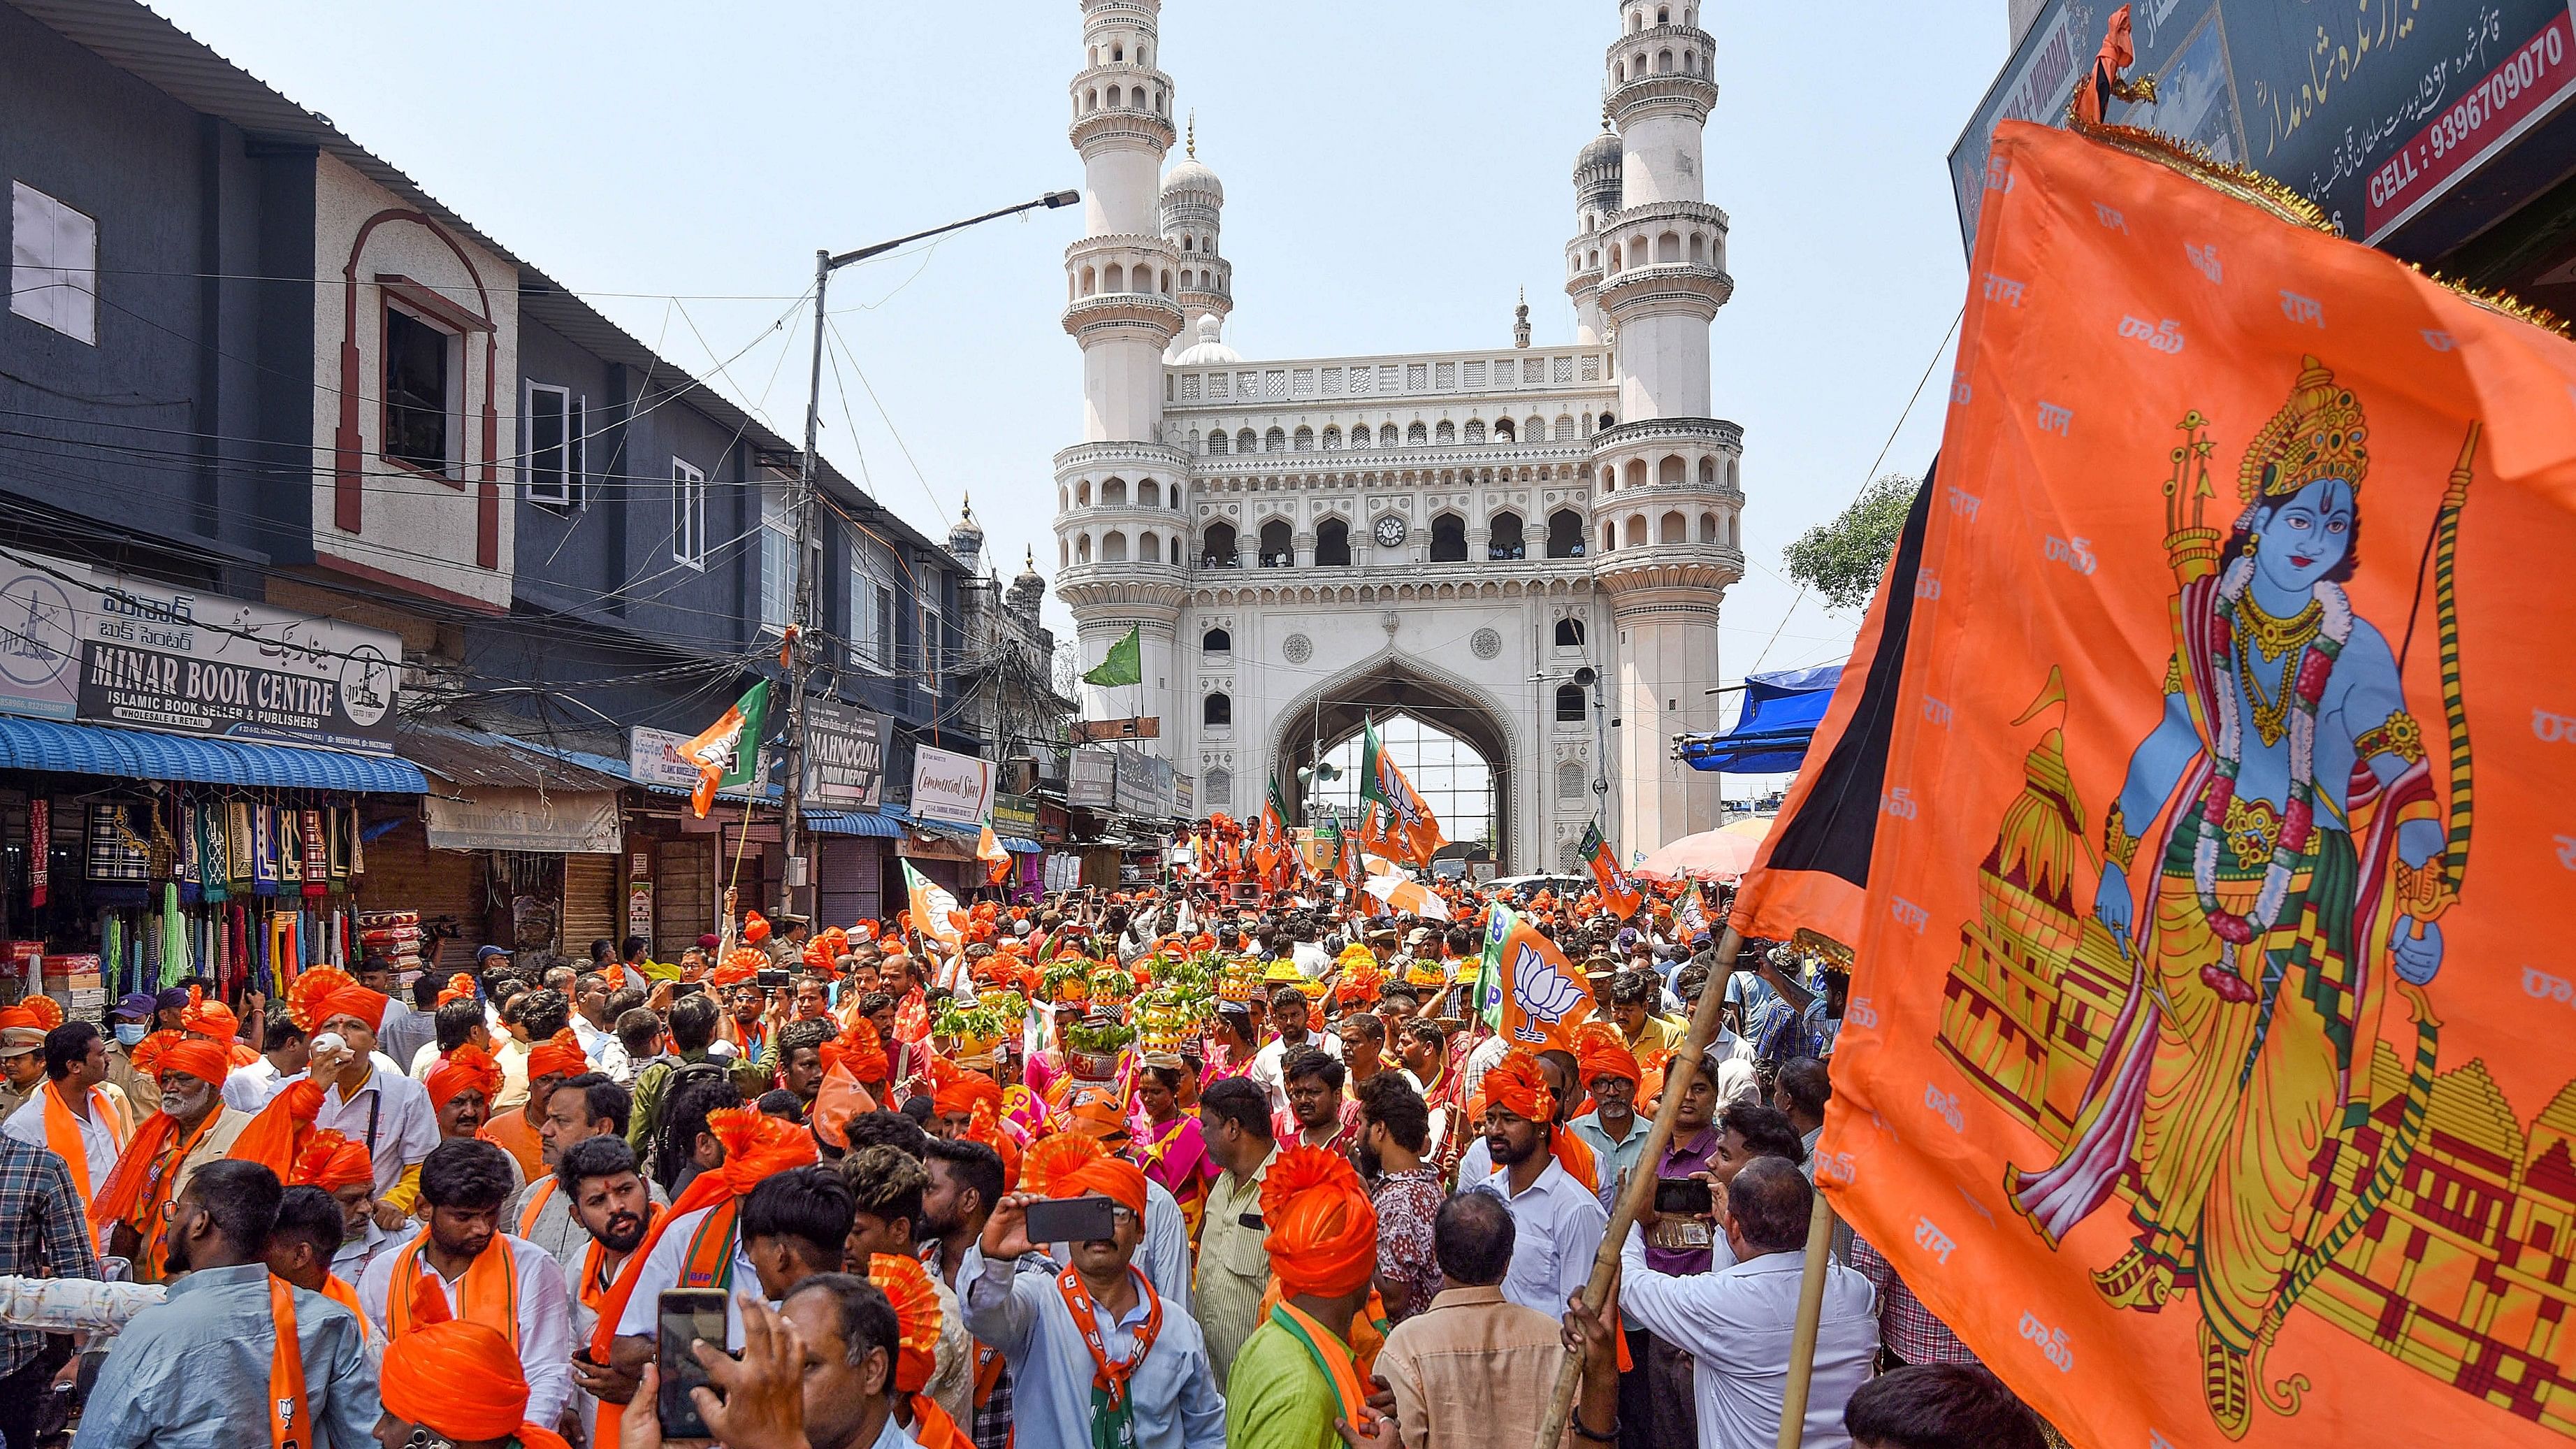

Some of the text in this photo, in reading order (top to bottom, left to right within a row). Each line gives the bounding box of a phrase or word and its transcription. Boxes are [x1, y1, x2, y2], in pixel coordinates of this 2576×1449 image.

[2370, 151, 2418, 209] CELL
[2430, 27, 2563, 159] 9396709070
[2091, 200, 2129, 236] राम
[1982, 271, 2025, 308] राम
[2279, 288, 2327, 329] राम
[2118, 315, 2185, 354] రామ్
[2037, 401, 2074, 437] राम
[1948, 486, 1981, 524] राम
[2044, 535, 2097, 577] రామ్
[91, 645, 334, 717] MINAR BOOK CENTRE
[108, 690, 319, 729] ISLAMIC BOOK SELLER & PUBLISHERS
[121, 708, 205, 727] WHOLESALE & RETAIL
[1923, 693, 1955, 733] राम
[809, 731, 880, 770] MAHMOODIA
[822, 765, 869, 787] BOOK DEPOT
[918, 766, 979, 799] Commercial Store
[1491, 909, 1506, 943] B
[1891, 895, 1930, 935] राम
[1484, 985, 1503, 1012] P
[1925, 1081, 1964, 1133] రామ్
[1913, 1216, 1955, 1265] राम
[690, 1271, 712, 1282] BJP
[1064, 1274, 1077, 1289] B
[2019, 1310, 2072, 1373] రామ్
